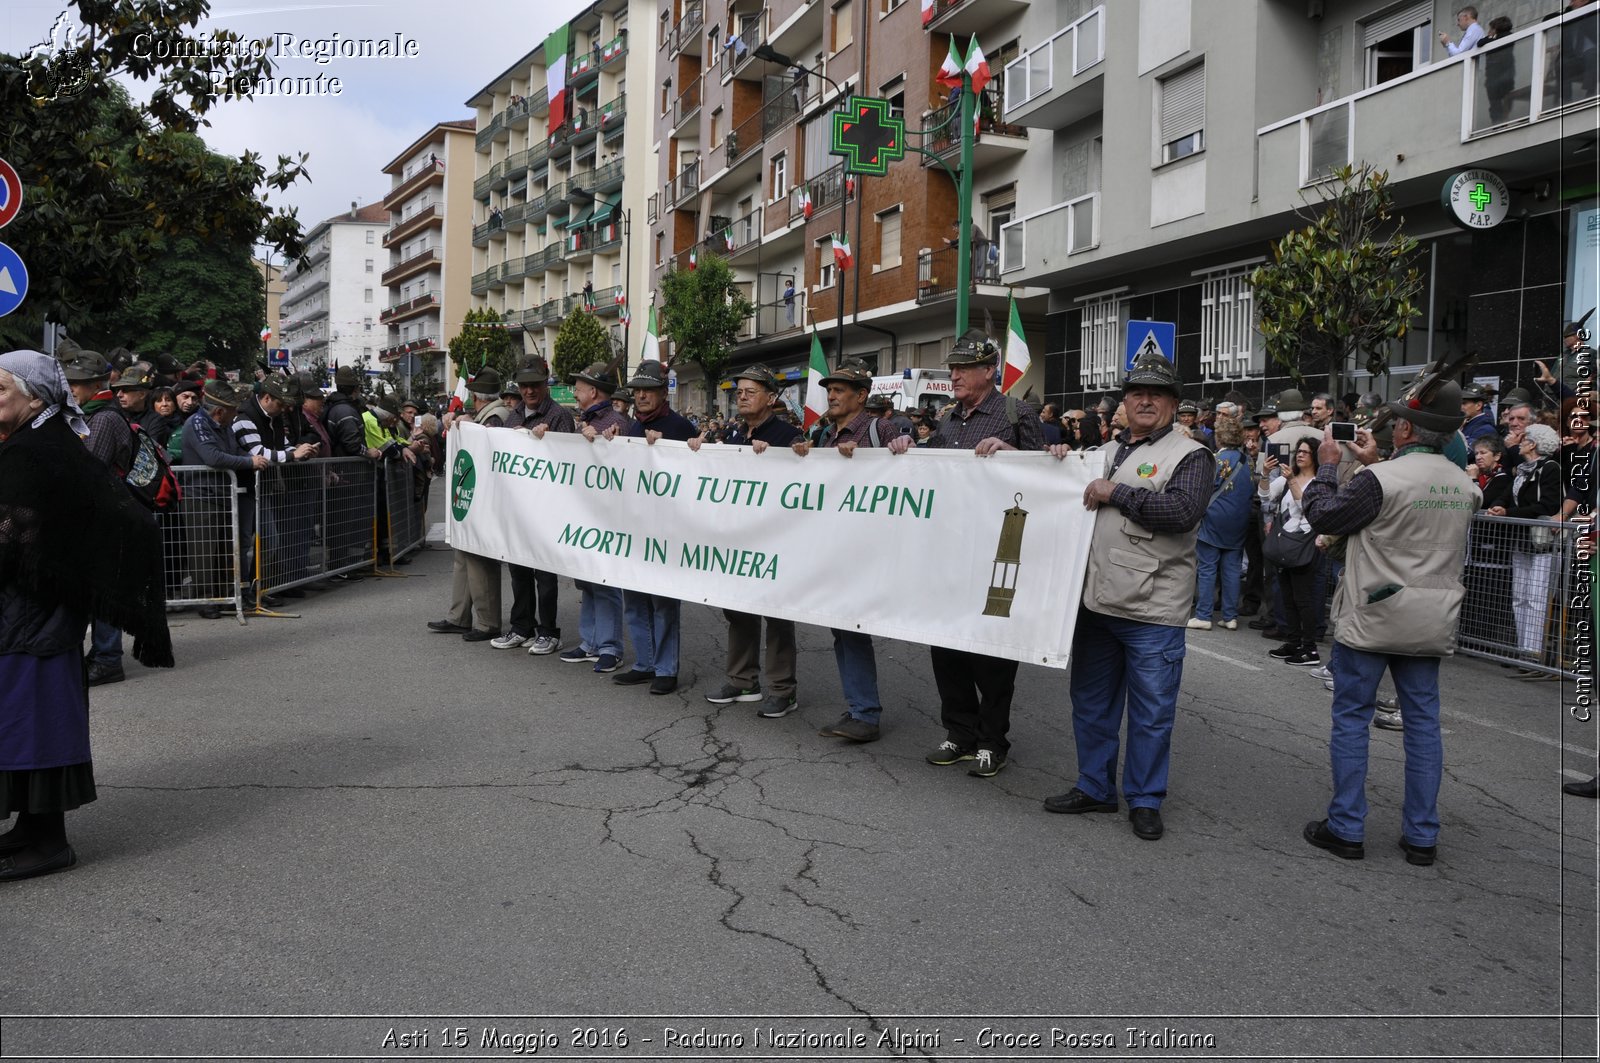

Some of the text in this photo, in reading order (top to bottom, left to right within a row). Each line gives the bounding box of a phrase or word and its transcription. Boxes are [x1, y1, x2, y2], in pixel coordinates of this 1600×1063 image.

[1452, 171, 1508, 206] FARMACIA ASSOCIATA
[1469, 212, 1493, 226] F.A.P.
[491, 450, 576, 486] PRESENTI
[584, 464, 625, 492] CON
[637, 469, 681, 498] NOI
[696, 476, 768, 507] TUTTI
[780, 482, 825, 511] GLI
[838, 484, 935, 519] ALPINI
[1412, 500, 1448, 510] SEZIONE
[557, 523, 779, 580] MORTI IN MINIERA
